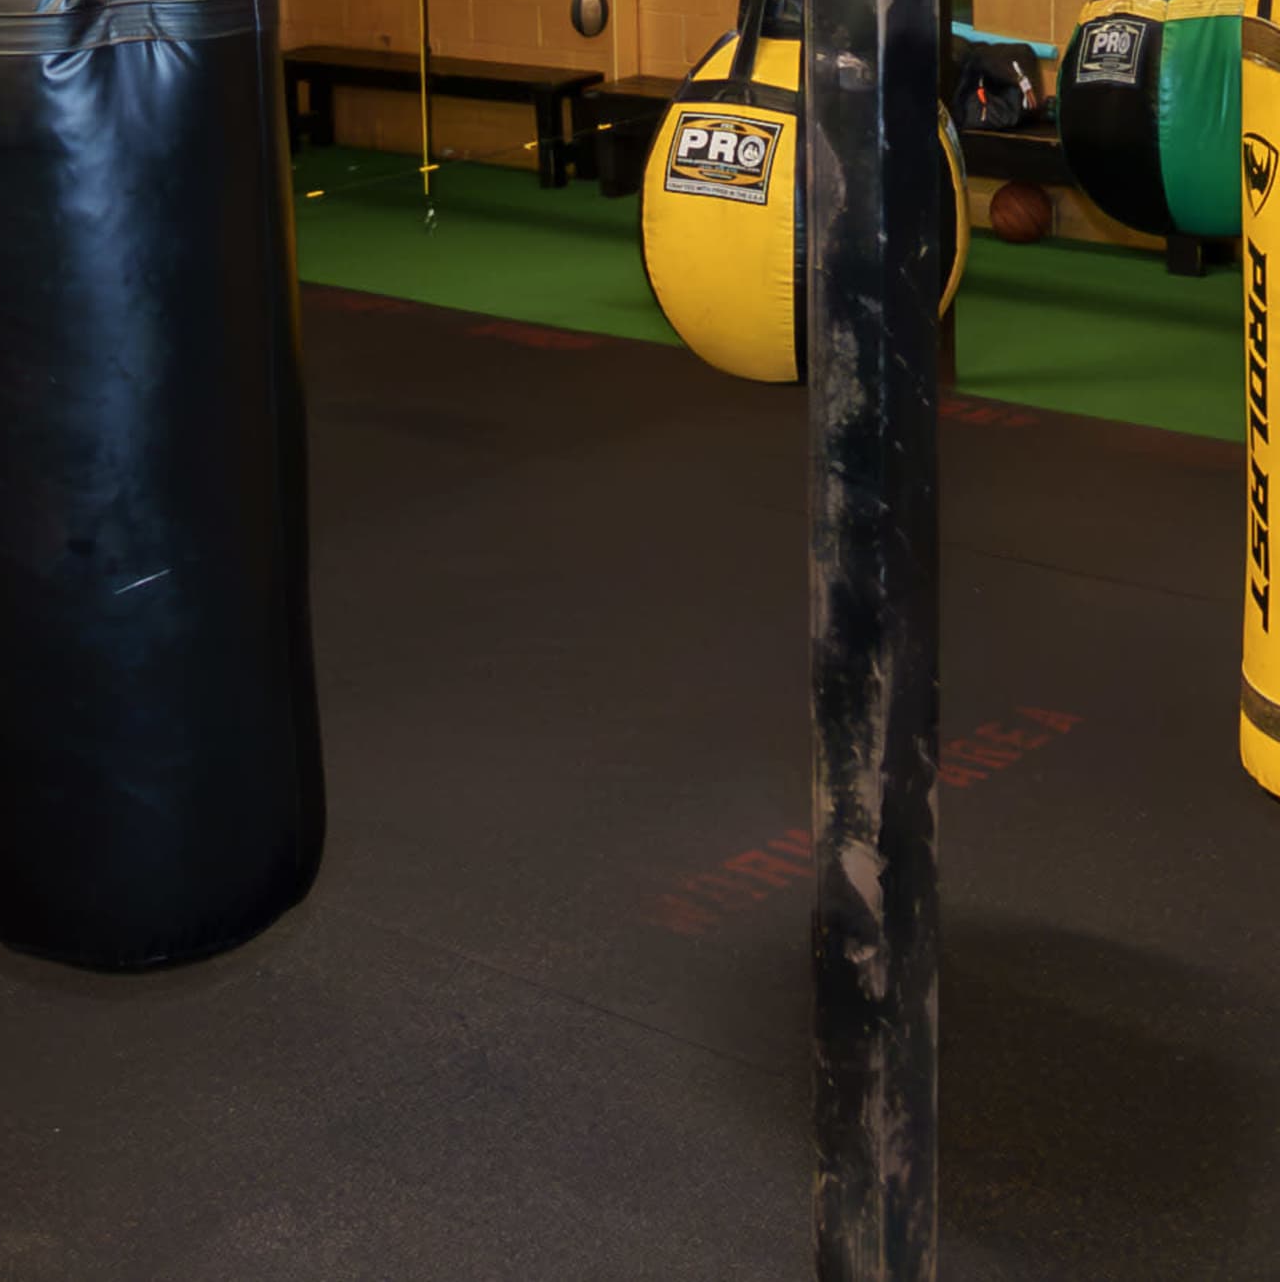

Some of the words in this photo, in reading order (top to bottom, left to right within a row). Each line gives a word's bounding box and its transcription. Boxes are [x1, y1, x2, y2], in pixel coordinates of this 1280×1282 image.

[1092, 31, 1131, 54] PRO
[678, 128, 765, 168] PRO
[1247, 236, 1270, 634] PROLAST
